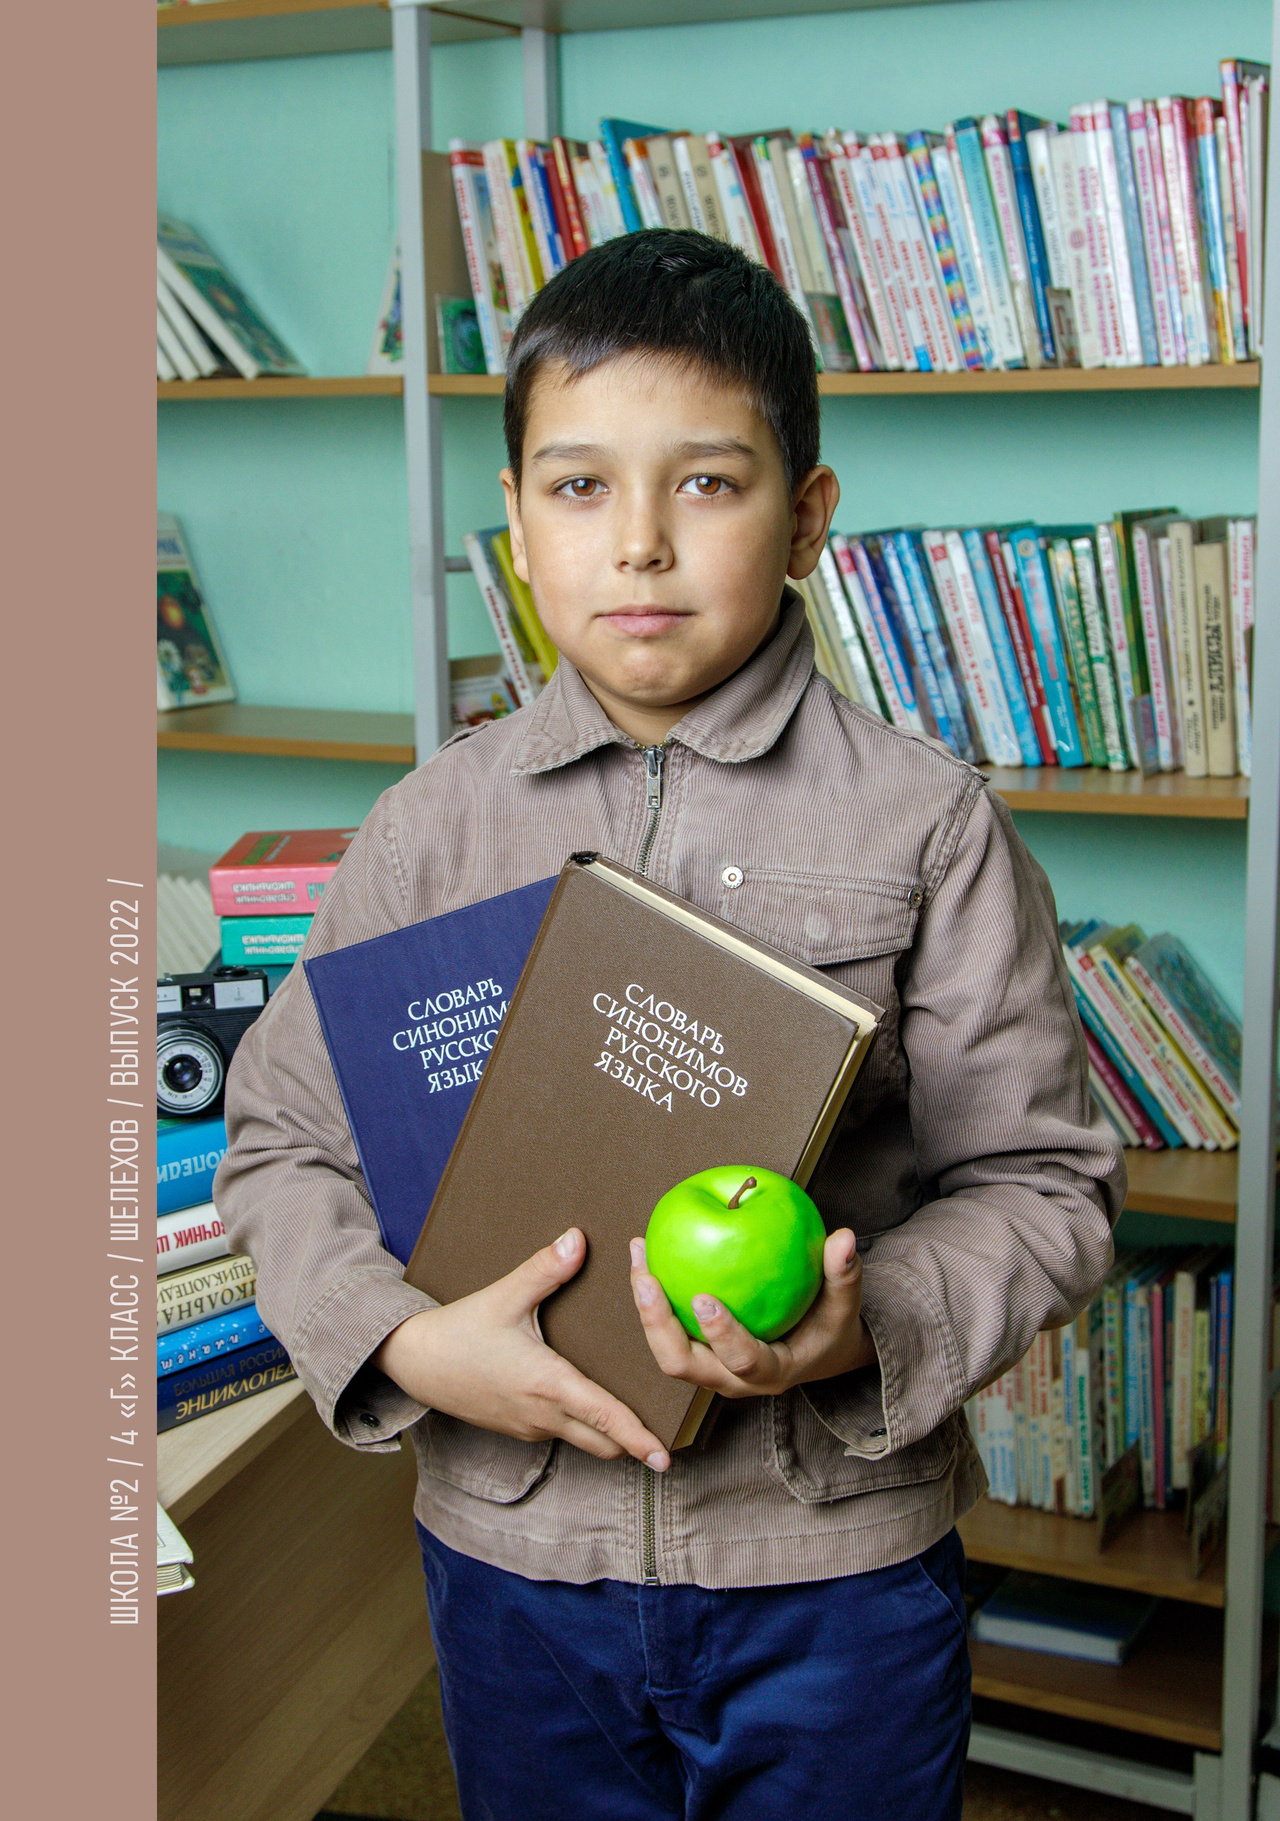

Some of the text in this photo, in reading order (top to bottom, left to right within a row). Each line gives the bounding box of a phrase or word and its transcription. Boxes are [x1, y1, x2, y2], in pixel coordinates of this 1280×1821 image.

[392, 1001, 512, 1052] СИНОНИМ
[407, 977, 503, 1022] СЛОВАРЬ
[625, 983, 725, 1056] СЛОВАРЬ
[592, 992, 749, 1098] СИНОНИМОВ
[604, 1026, 722, 1109] РУССКОГО
[428, 1059, 483, 1094] ЯЗЫК
[593, 1051, 675, 1113] ЯЗЫКА
[173, 1363, 236, 1397] БОЛЬШАЯ
